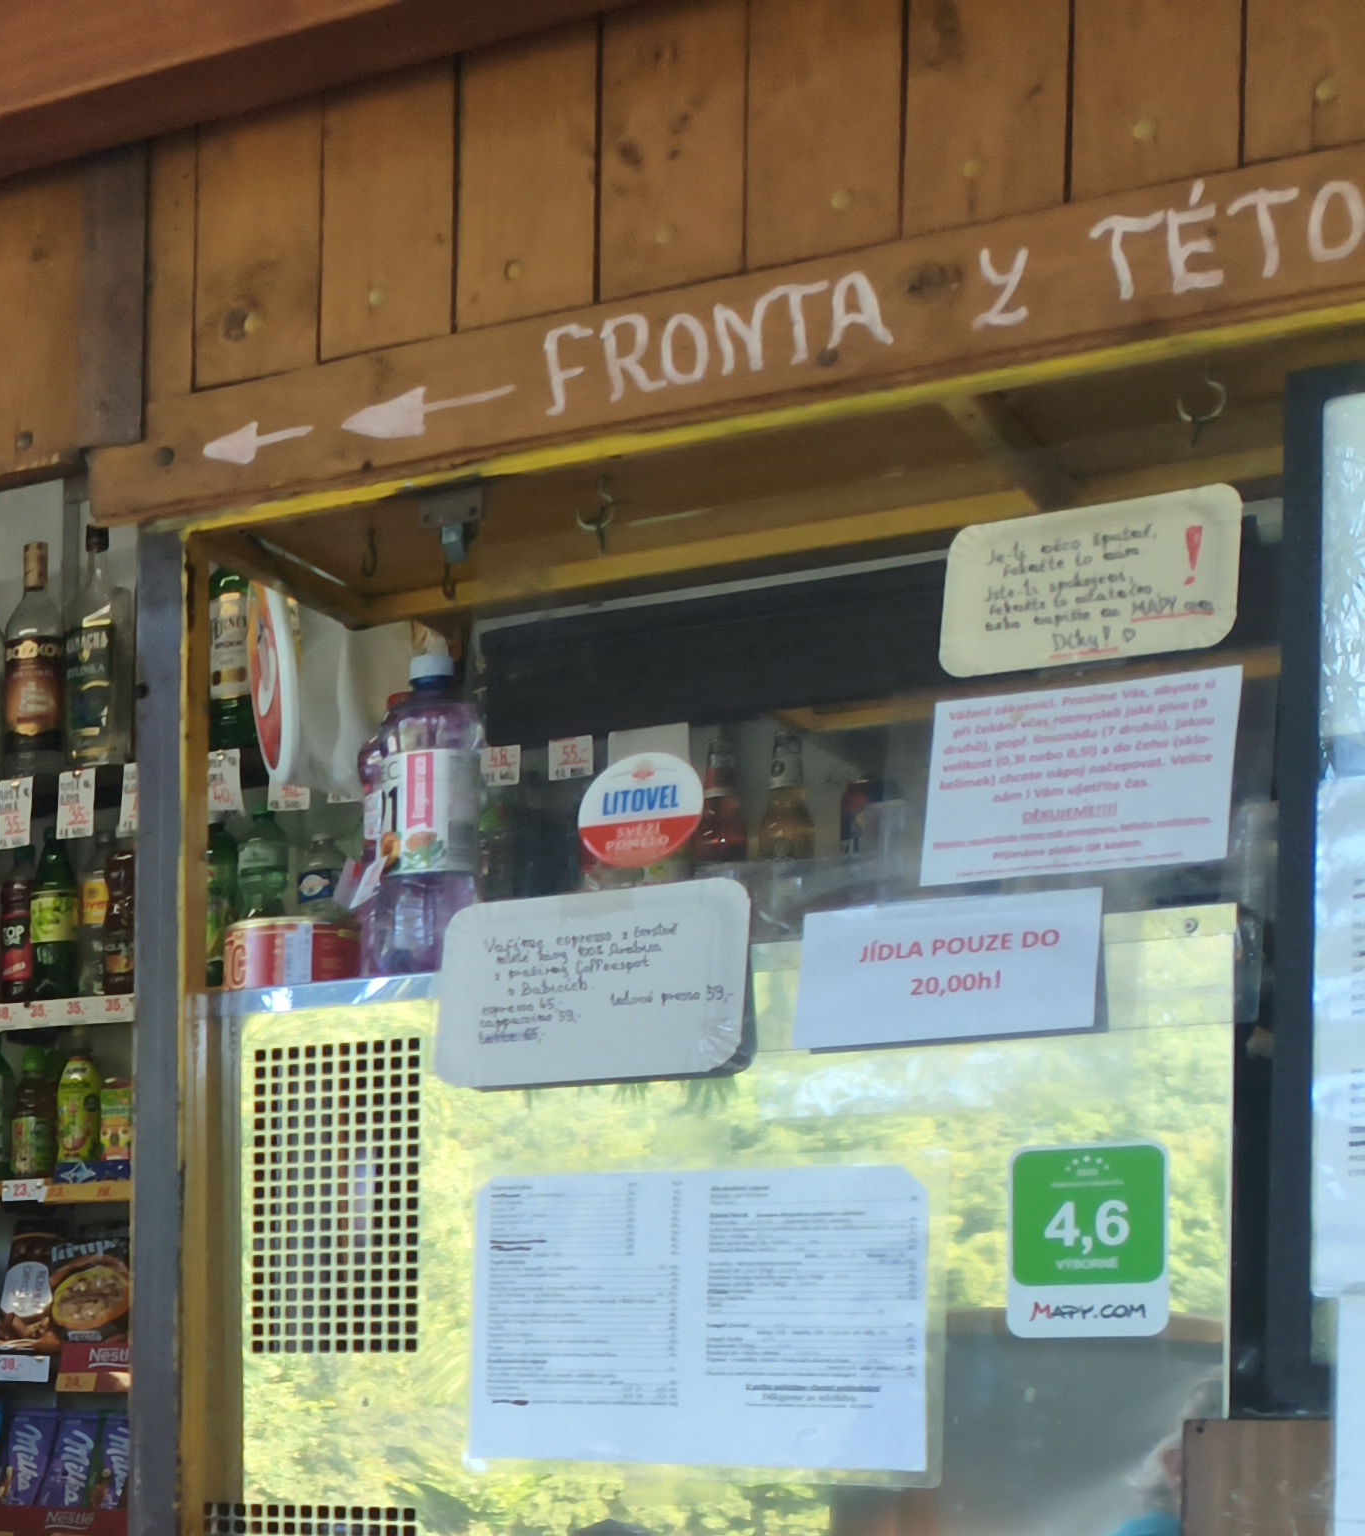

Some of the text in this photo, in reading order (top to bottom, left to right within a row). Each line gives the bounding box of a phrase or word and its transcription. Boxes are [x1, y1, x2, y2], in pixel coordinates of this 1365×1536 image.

[543, 270, 893, 417] FRONTA
[1088, 179, 1365, 301] TÉTO
[603, 785, 679, 817] LITOVEL
[859, 929, 1061, 963] JÍDLA POUZE DO
[911, 969, 1002, 998] 20,00h!
[1044, 1199, 1130, 1255] 4,6
